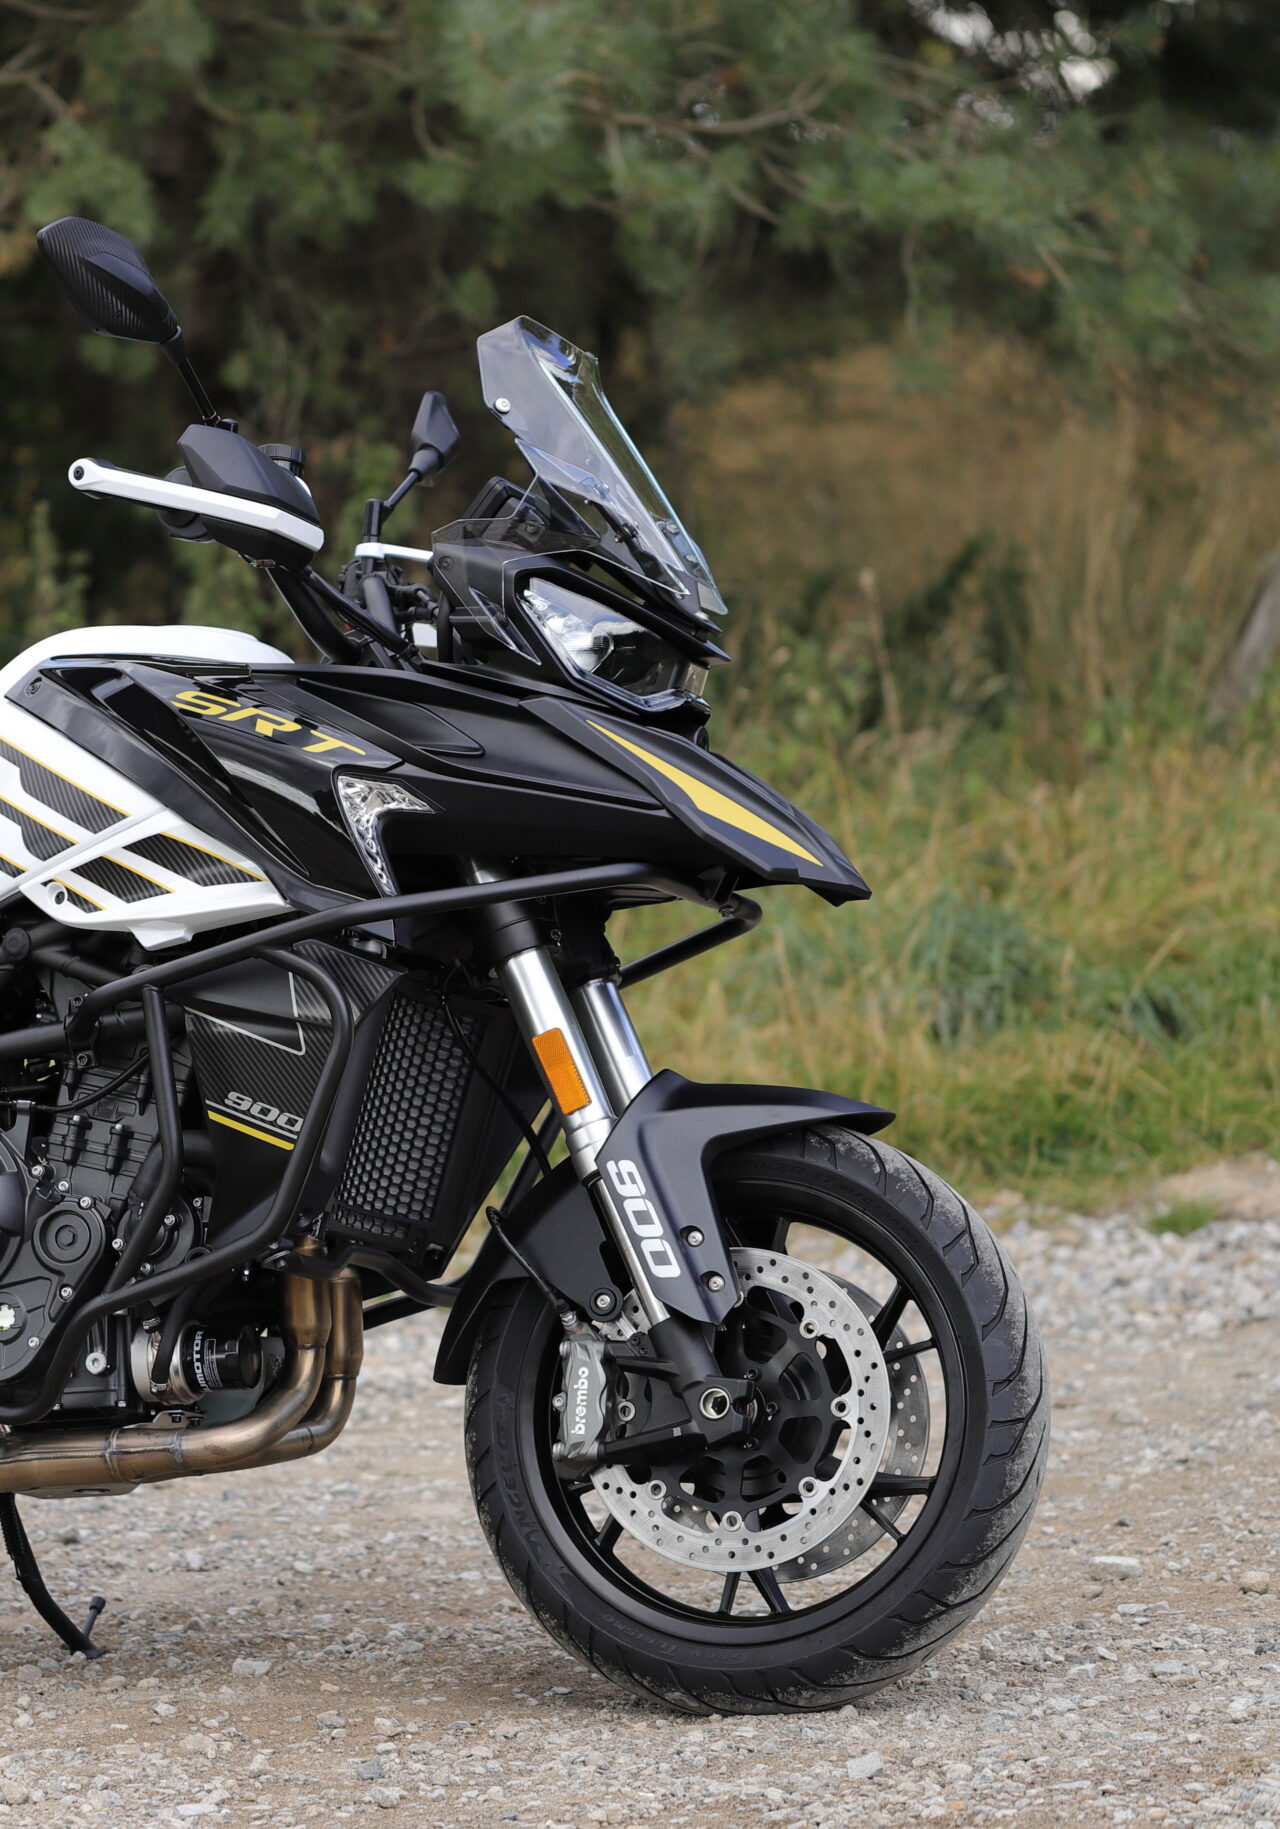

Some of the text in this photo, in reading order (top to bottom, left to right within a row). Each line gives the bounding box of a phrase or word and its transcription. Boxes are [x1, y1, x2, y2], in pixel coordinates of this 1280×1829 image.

[170, 690, 367, 756] SRT
[224, 1091, 305, 1133] 900
[606, 1159, 681, 1278] 900
[571, 1366, 590, 1435] brembo
